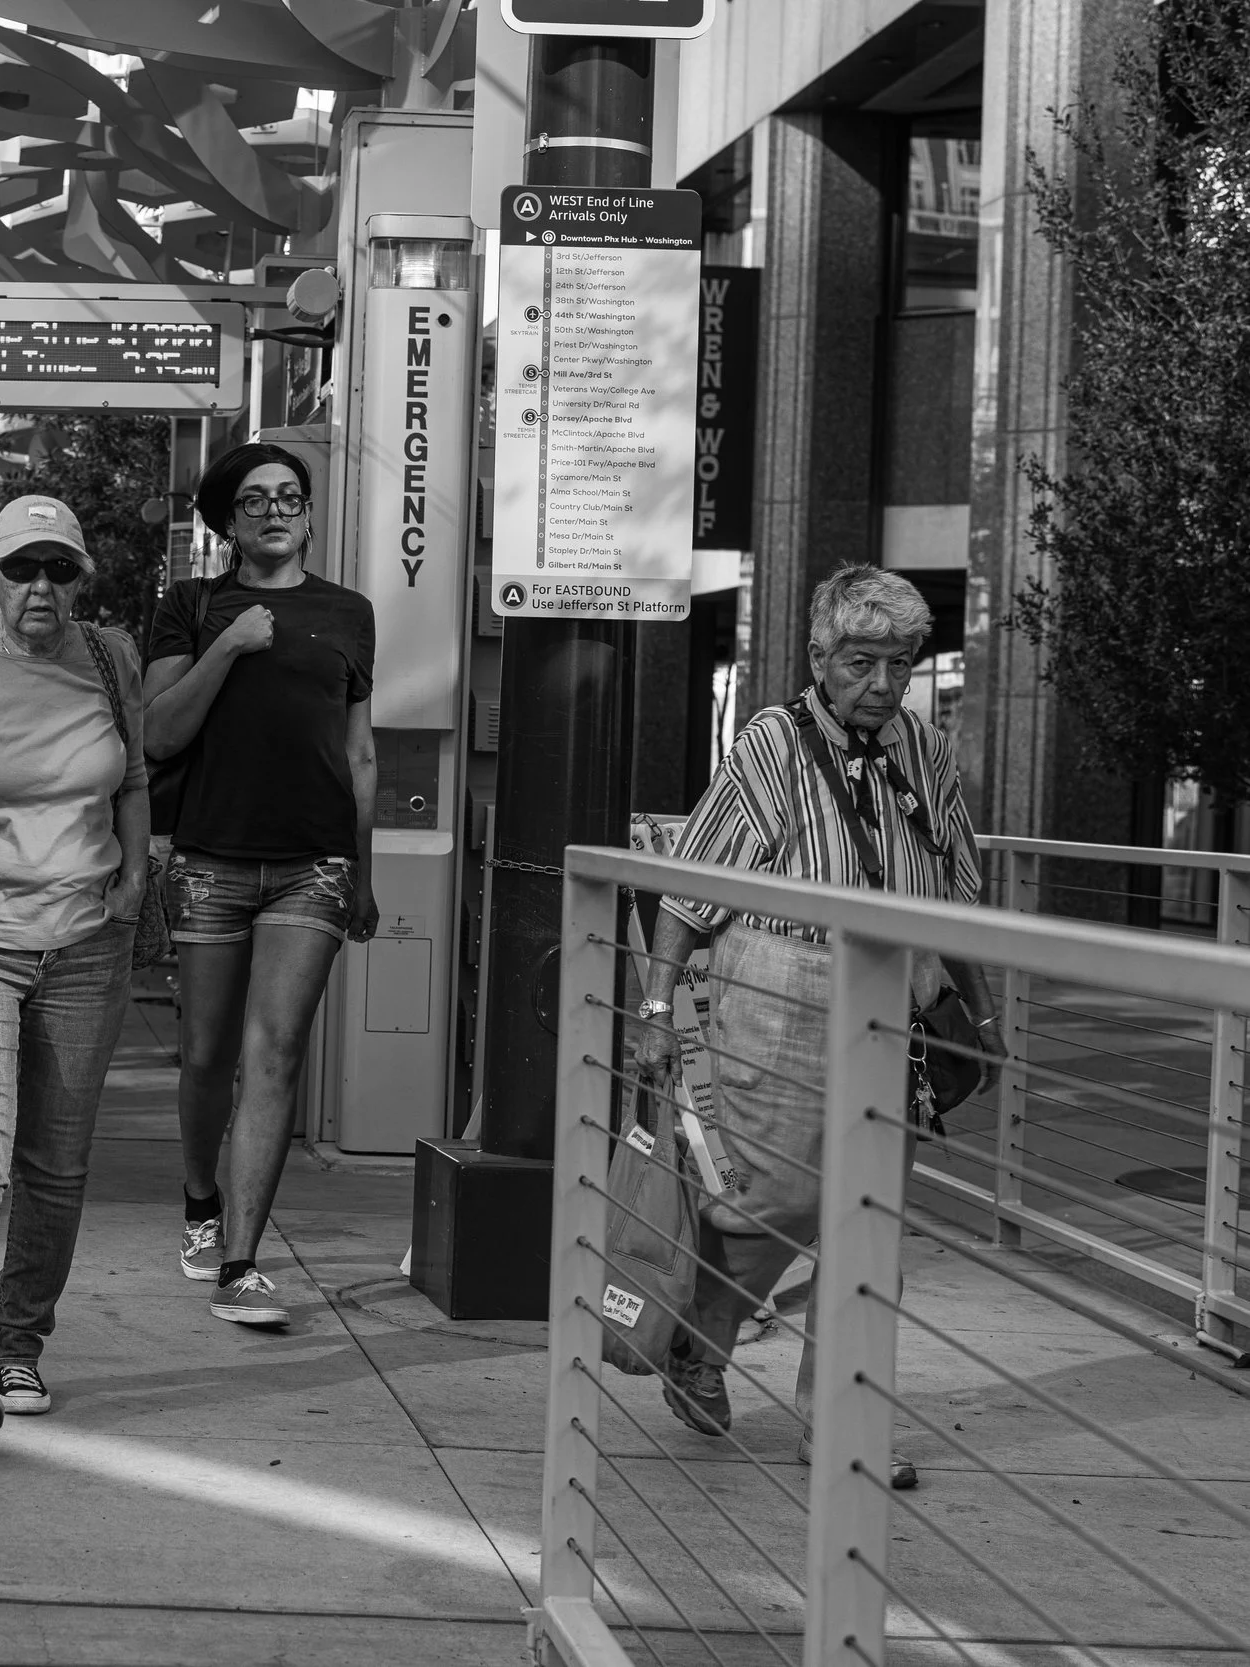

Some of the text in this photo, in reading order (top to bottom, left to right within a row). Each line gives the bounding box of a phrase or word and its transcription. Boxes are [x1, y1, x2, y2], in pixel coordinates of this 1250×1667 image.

[550, 195, 654, 208] WEST End of Line
[520, 200, 535, 213] A
[549, 211, 627, 224] Arrivals Only
[646, 237, 692, 246] Washington
[577, 283, 625, 291] St/Jefferson
[576, 298, 634, 306] St/Washington
[577, 312, 635, 321] St/Washington
[576, 327, 633, 336] St/Washington
[579, 342, 638, 350] Dr/Washington
[582, 357, 652, 366] Pkwy/Washington
[590, 386, 639, 395] Way/College
[553, 401, 591, 409] University
[697, 278, 730, 537] WREN & WOLF
[552, 415, 612, 423] Dorsey/Apache
[552, 429, 625, 438] McClintock/Apache
[401, 306, 431, 588] EMERGENCY
[552, 444, 635, 453] Smith-Martin/Apache
[589, 460, 636, 468] Fwy/Apache
[551, 474, 611, 482] Sycamore/Main
[550, 503, 580, 512] Country
[583, 504, 622, 512] Club/Main
[549, 547, 578, 556] Stapley
[532, 584, 631, 596] For EASTBOUND
[506, 589, 520, 602] A
[532, 599, 685, 613] Use Jefferson St Platform
